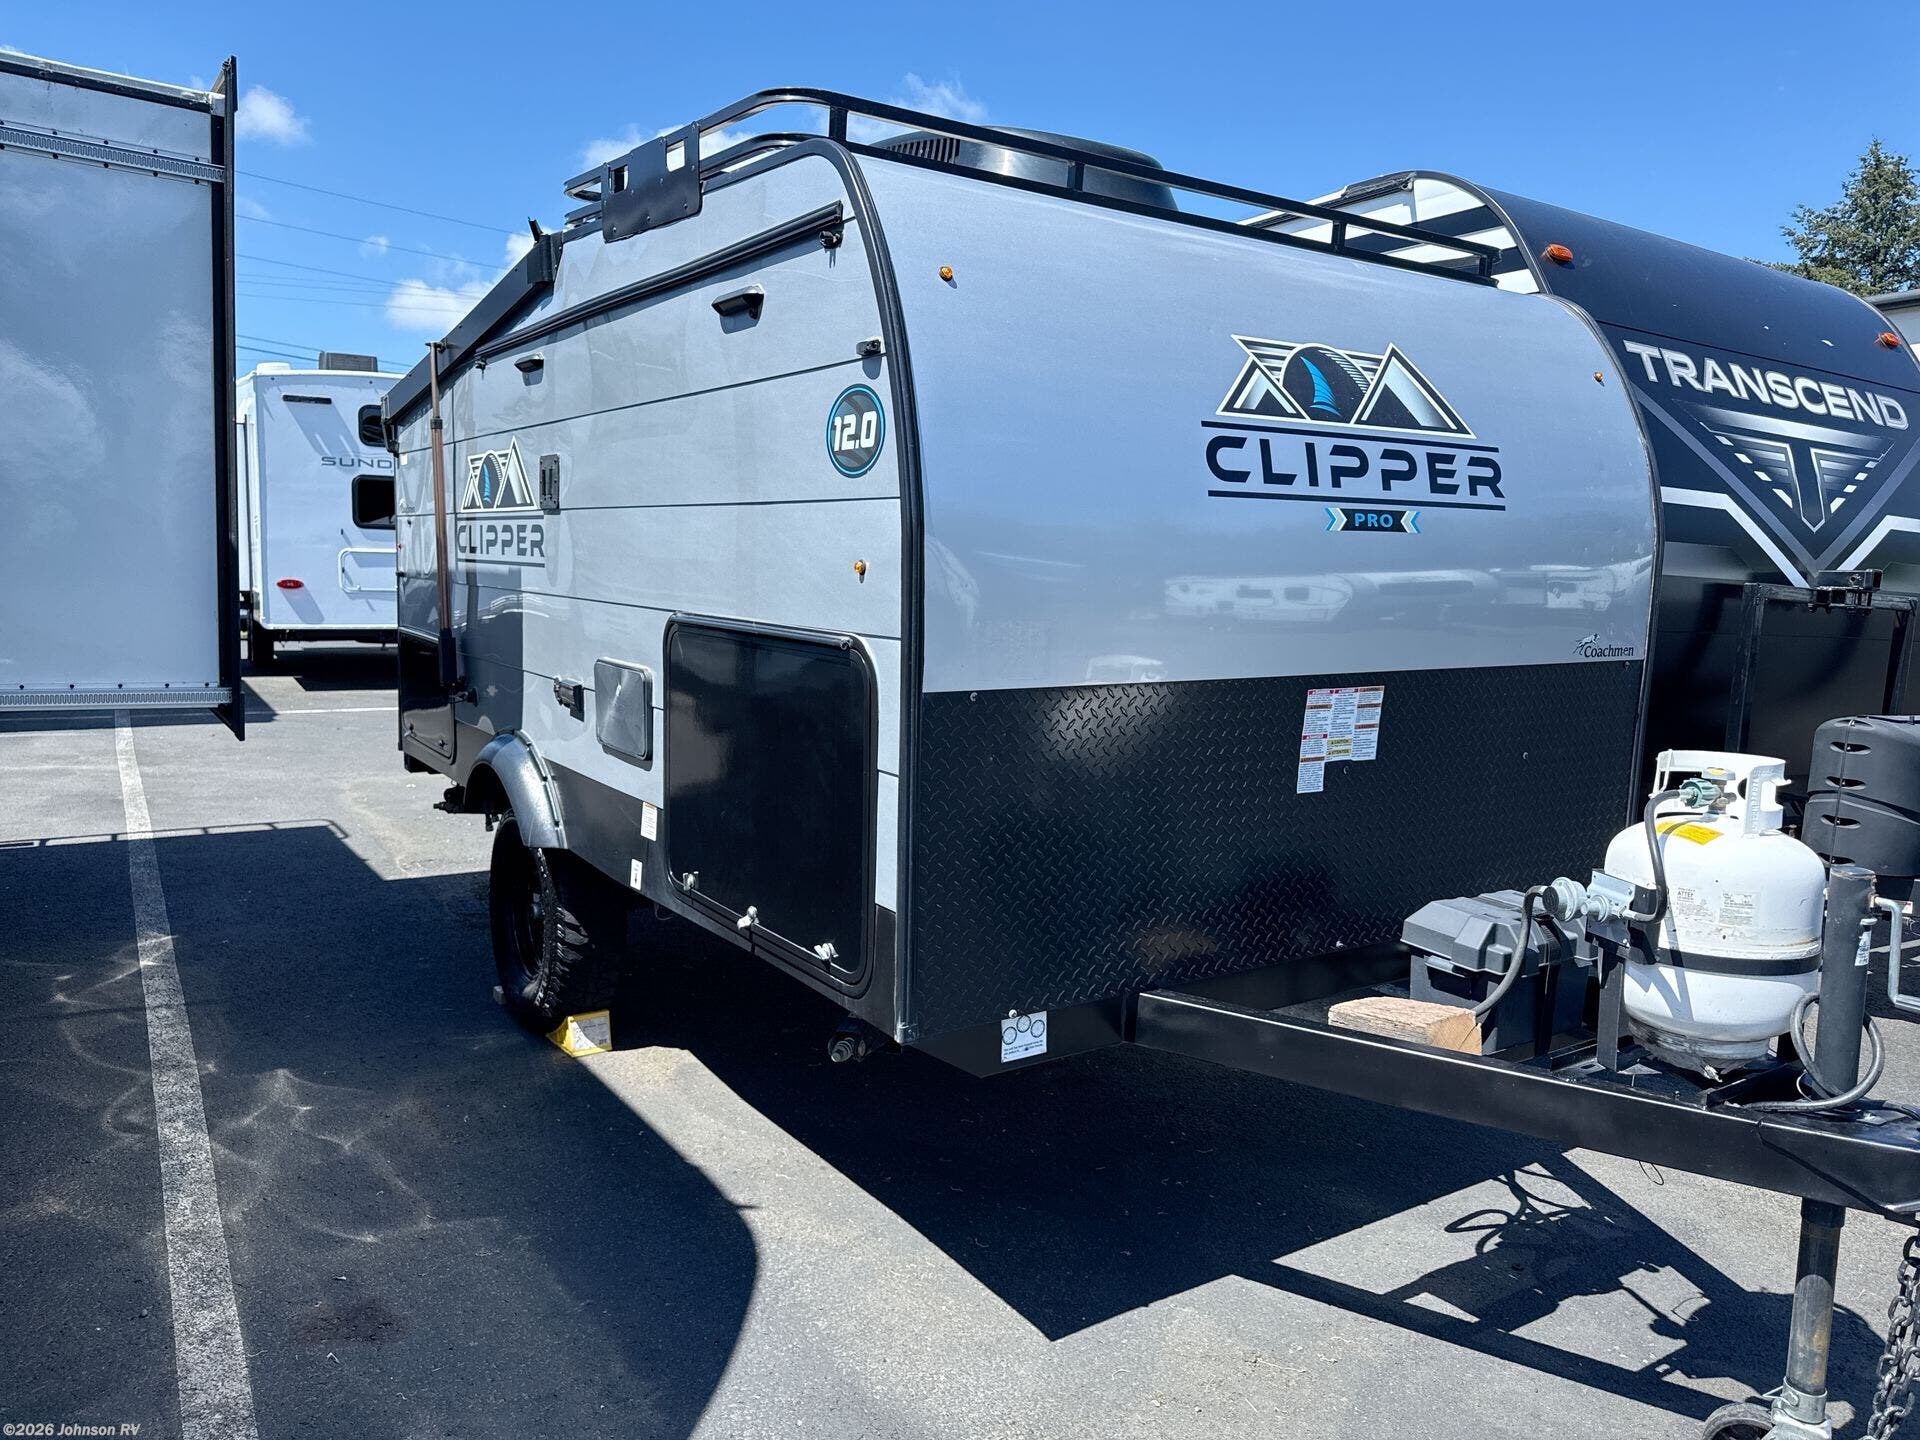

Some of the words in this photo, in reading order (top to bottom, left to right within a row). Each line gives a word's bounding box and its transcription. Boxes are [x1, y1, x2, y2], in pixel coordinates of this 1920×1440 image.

[1623, 340, 1909, 430] TRANSCEND
[833, 410, 877, 452] 12.0
[1205, 435, 1506, 498] CLIPPER
[1354, 513, 1394, 528] PRO
[457, 523, 545, 558] CLIPPER
[1584, 643, 1634, 658] Coachmen
